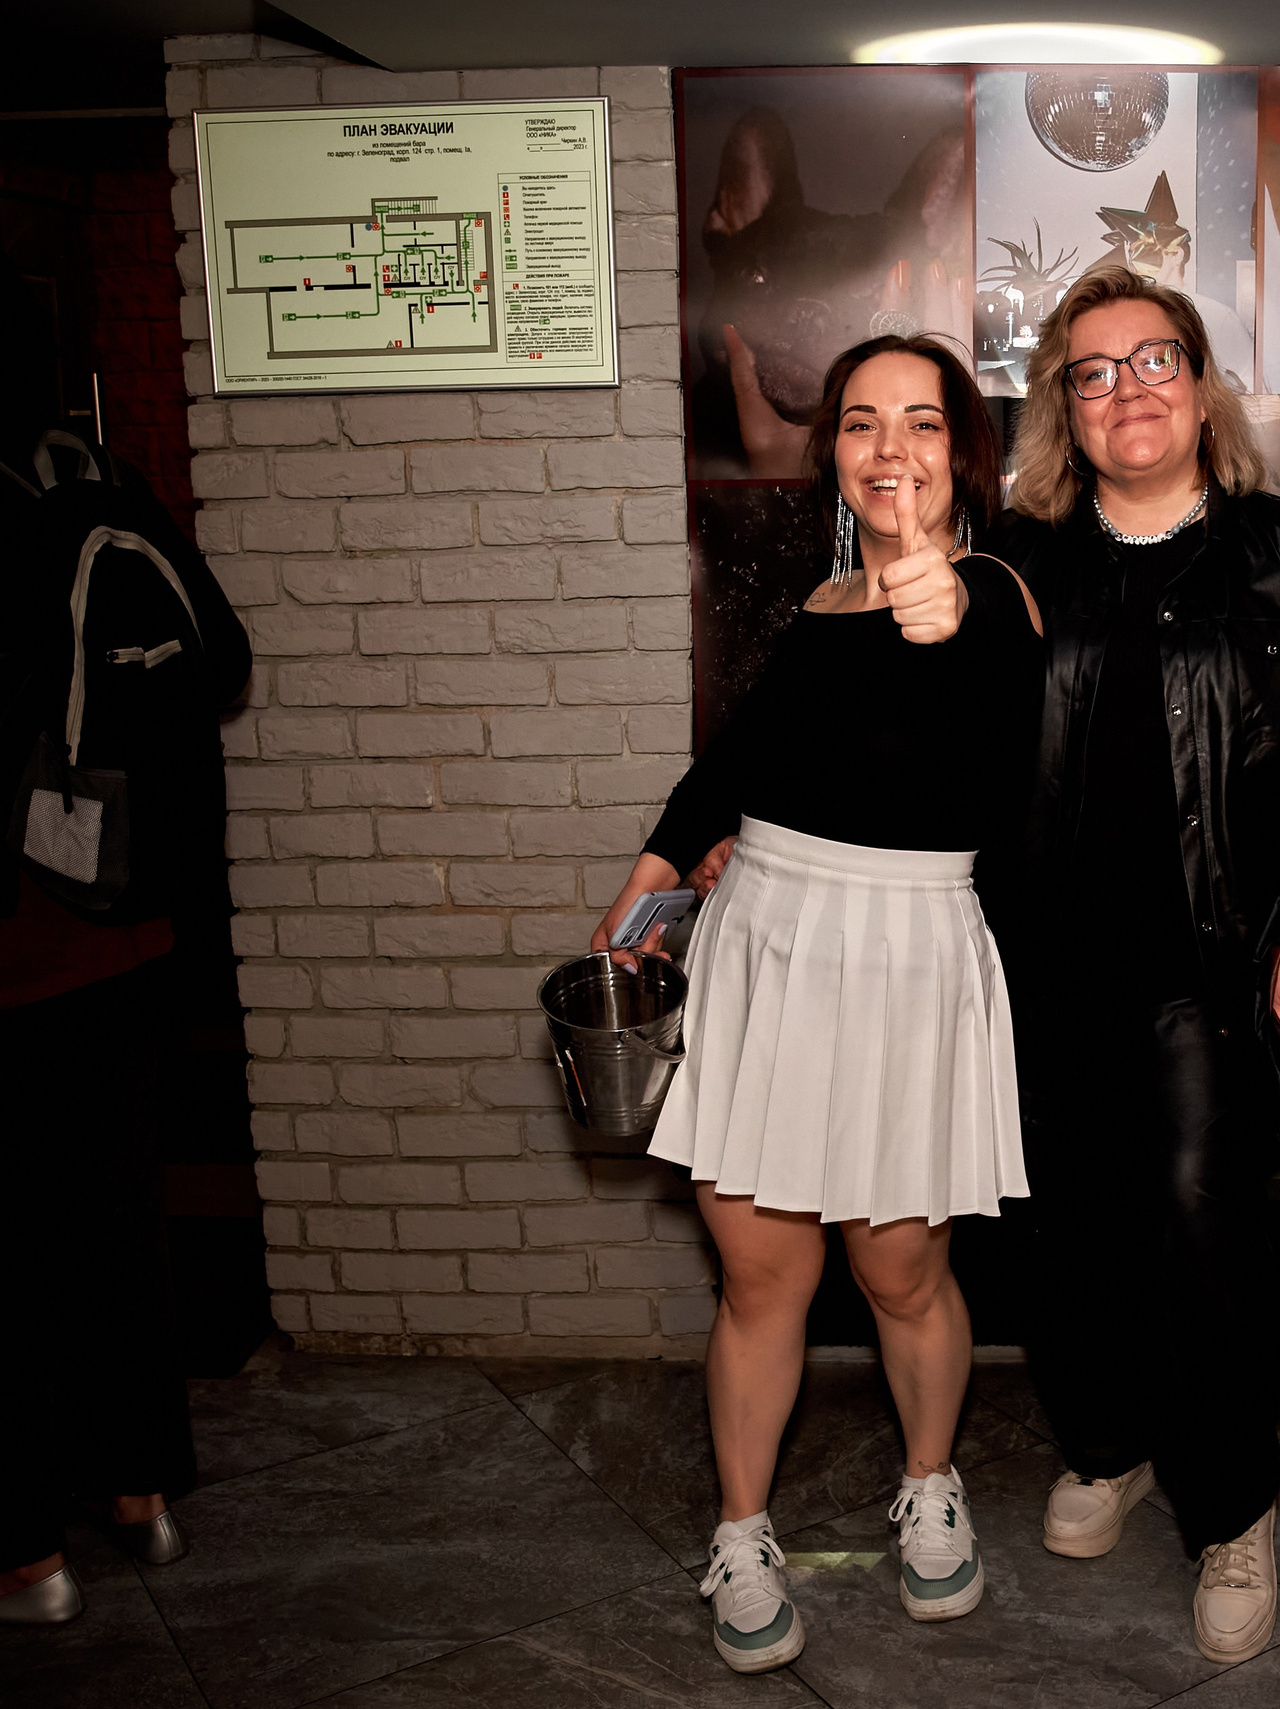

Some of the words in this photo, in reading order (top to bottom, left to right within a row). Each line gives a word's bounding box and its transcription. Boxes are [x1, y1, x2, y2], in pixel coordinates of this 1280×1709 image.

[344, 125, 377, 137] ПЛАН
[380, 122, 454, 136] ЭВАКУАЦИИ
[362, 149, 395, 157] Зеленоград,
